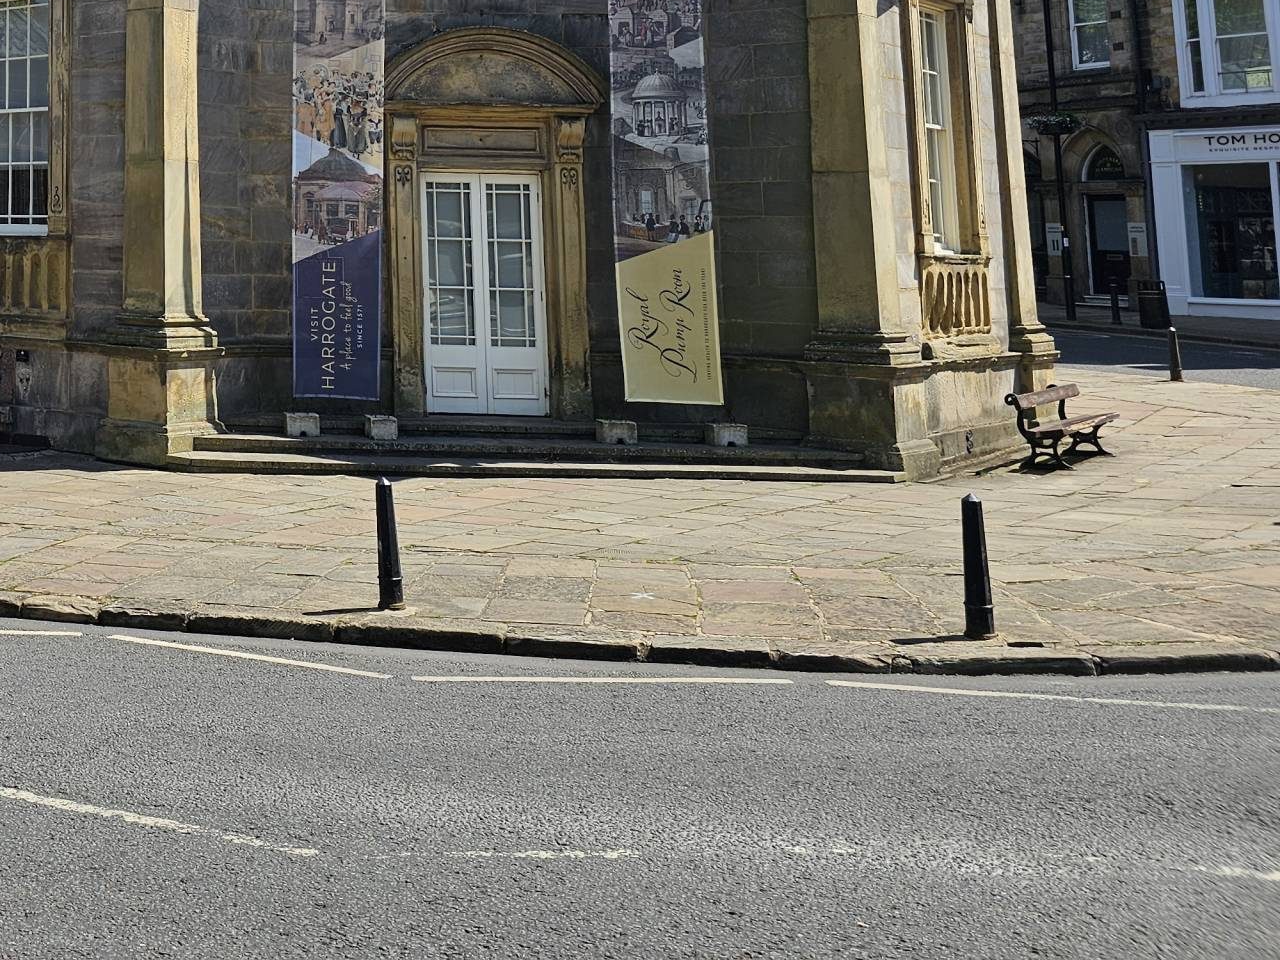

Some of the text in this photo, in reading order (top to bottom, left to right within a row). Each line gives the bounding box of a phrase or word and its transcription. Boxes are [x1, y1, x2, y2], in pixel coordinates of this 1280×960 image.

[1203, 134, 1246, 146] TOM
[310, 307, 319, 342] VISIT
[321, 261, 336, 389] HARROGATE
[339, 281, 358, 371] A place to feel good
[356, 324, 364, 349] SINCE
[625, 287, 669, 354] Royal
[658, 267, 698, 384] Pump Room
